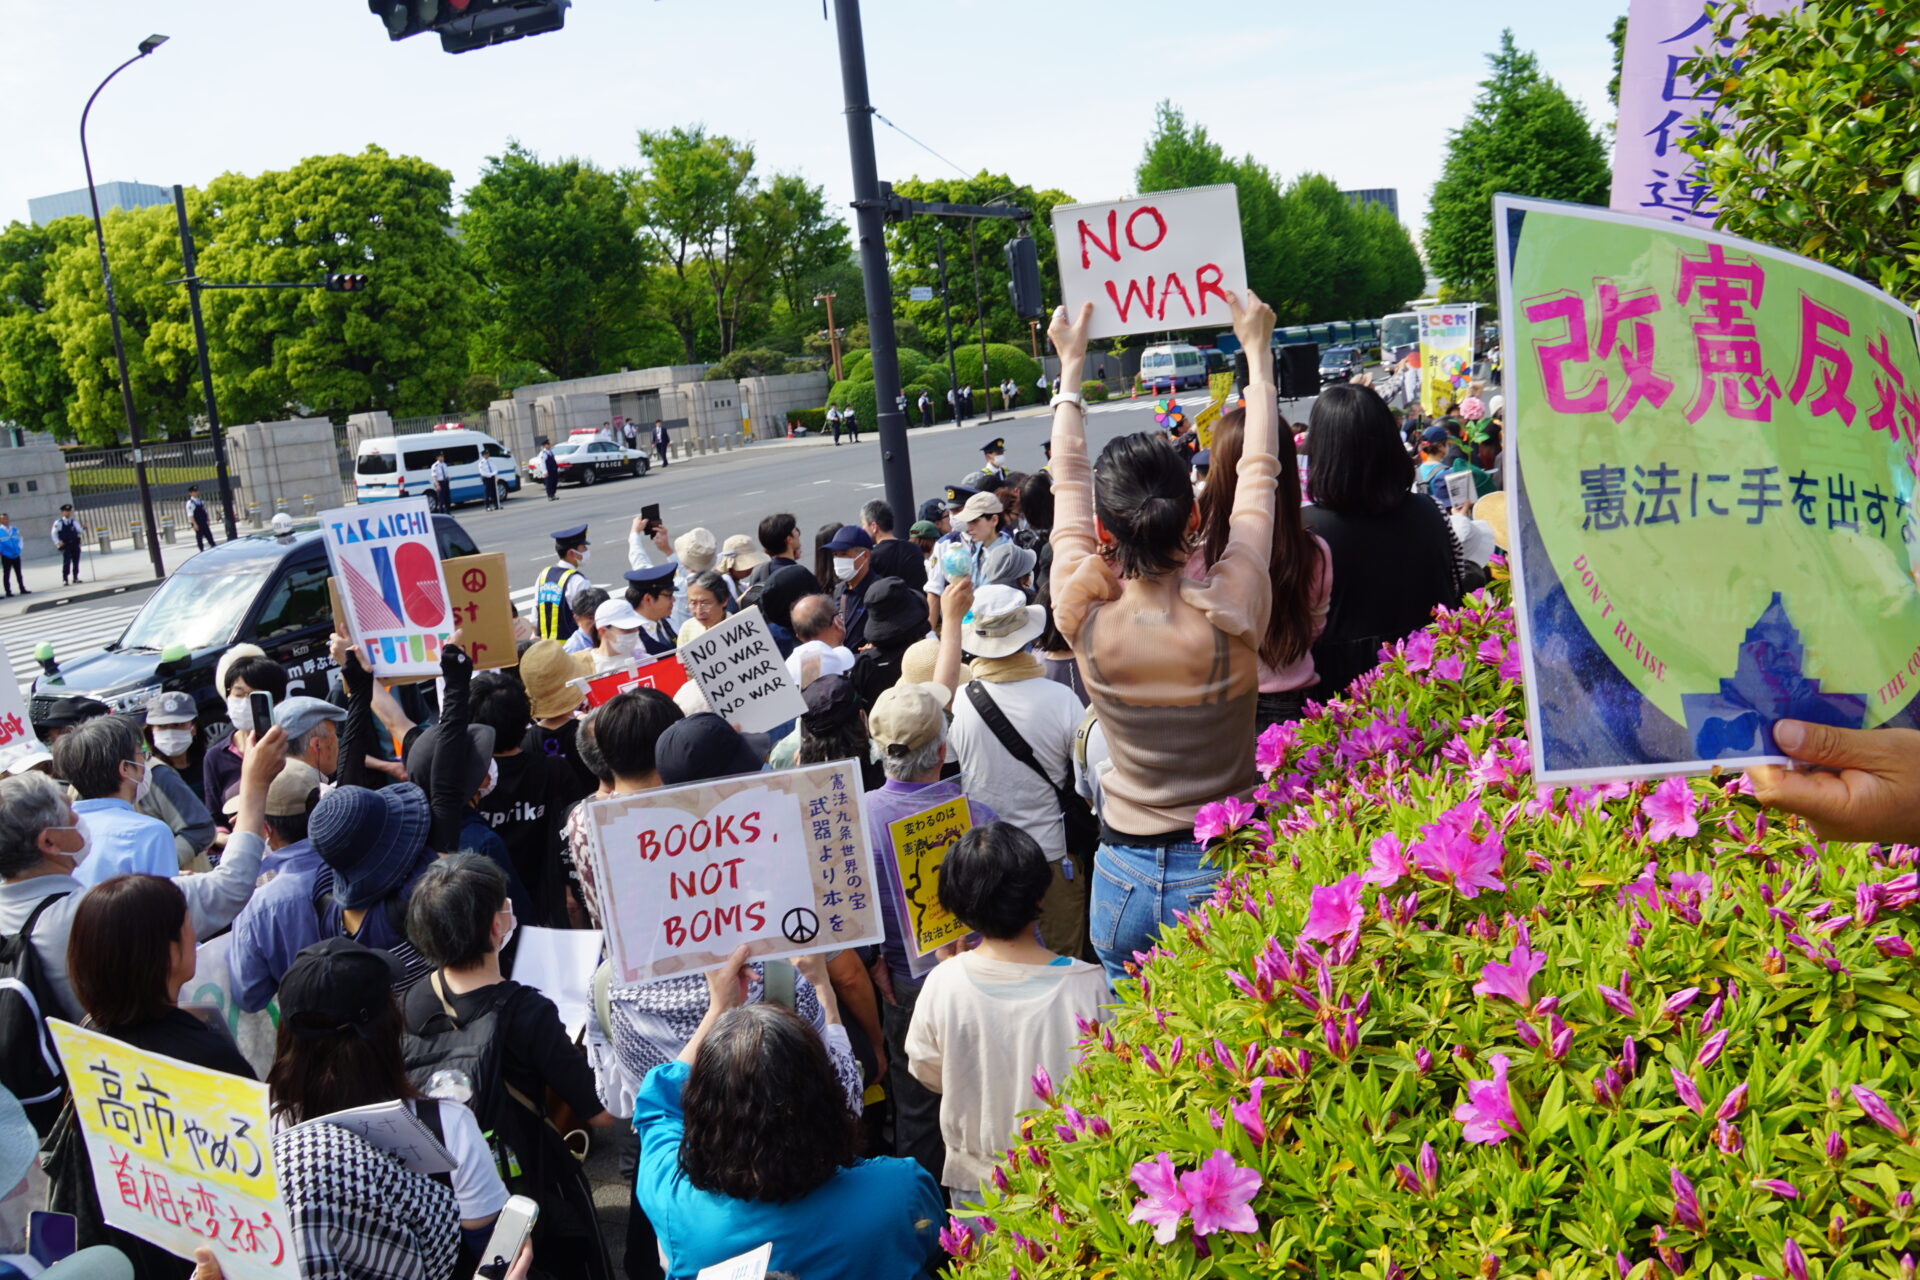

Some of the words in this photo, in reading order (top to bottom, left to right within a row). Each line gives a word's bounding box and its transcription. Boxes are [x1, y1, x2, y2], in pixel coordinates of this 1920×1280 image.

[1077, 205, 1168, 270] NO
[1104, 263, 1230, 323] WAR
[331, 511, 429, 545] TAKAICHI
[339, 541, 446, 629] NO
[452, 601, 479, 626] st
[1573, 554, 1614, 619] DON'T
[1613, 619, 1667, 683] REVISE
[1877, 670, 1907, 705] THE
[292, 645, 309, 657] km
[690, 640, 716, 664] NO
[720, 620, 760, 647] WAR
[701, 661, 727, 684] NO
[728, 640, 769, 664] WAR
[711, 680, 734, 702] NO
[738, 660, 778, 684] WAR
[720, 697, 745, 719] NO
[749, 676, 786, 700] WAR
[830, 773, 866, 910] 憲法九条世界の宝
[904, 807, 957, 837] 変わるのは
[669, 857, 746, 900] NOT
[809, 796, 844, 932] 武器より本を
[663, 901, 766, 948] BOMS
[922, 917, 963, 944] 政治と政
[89, 1059, 262, 1178] 高市やめろ
[109, 1145, 285, 1267] 首相を変えよう
